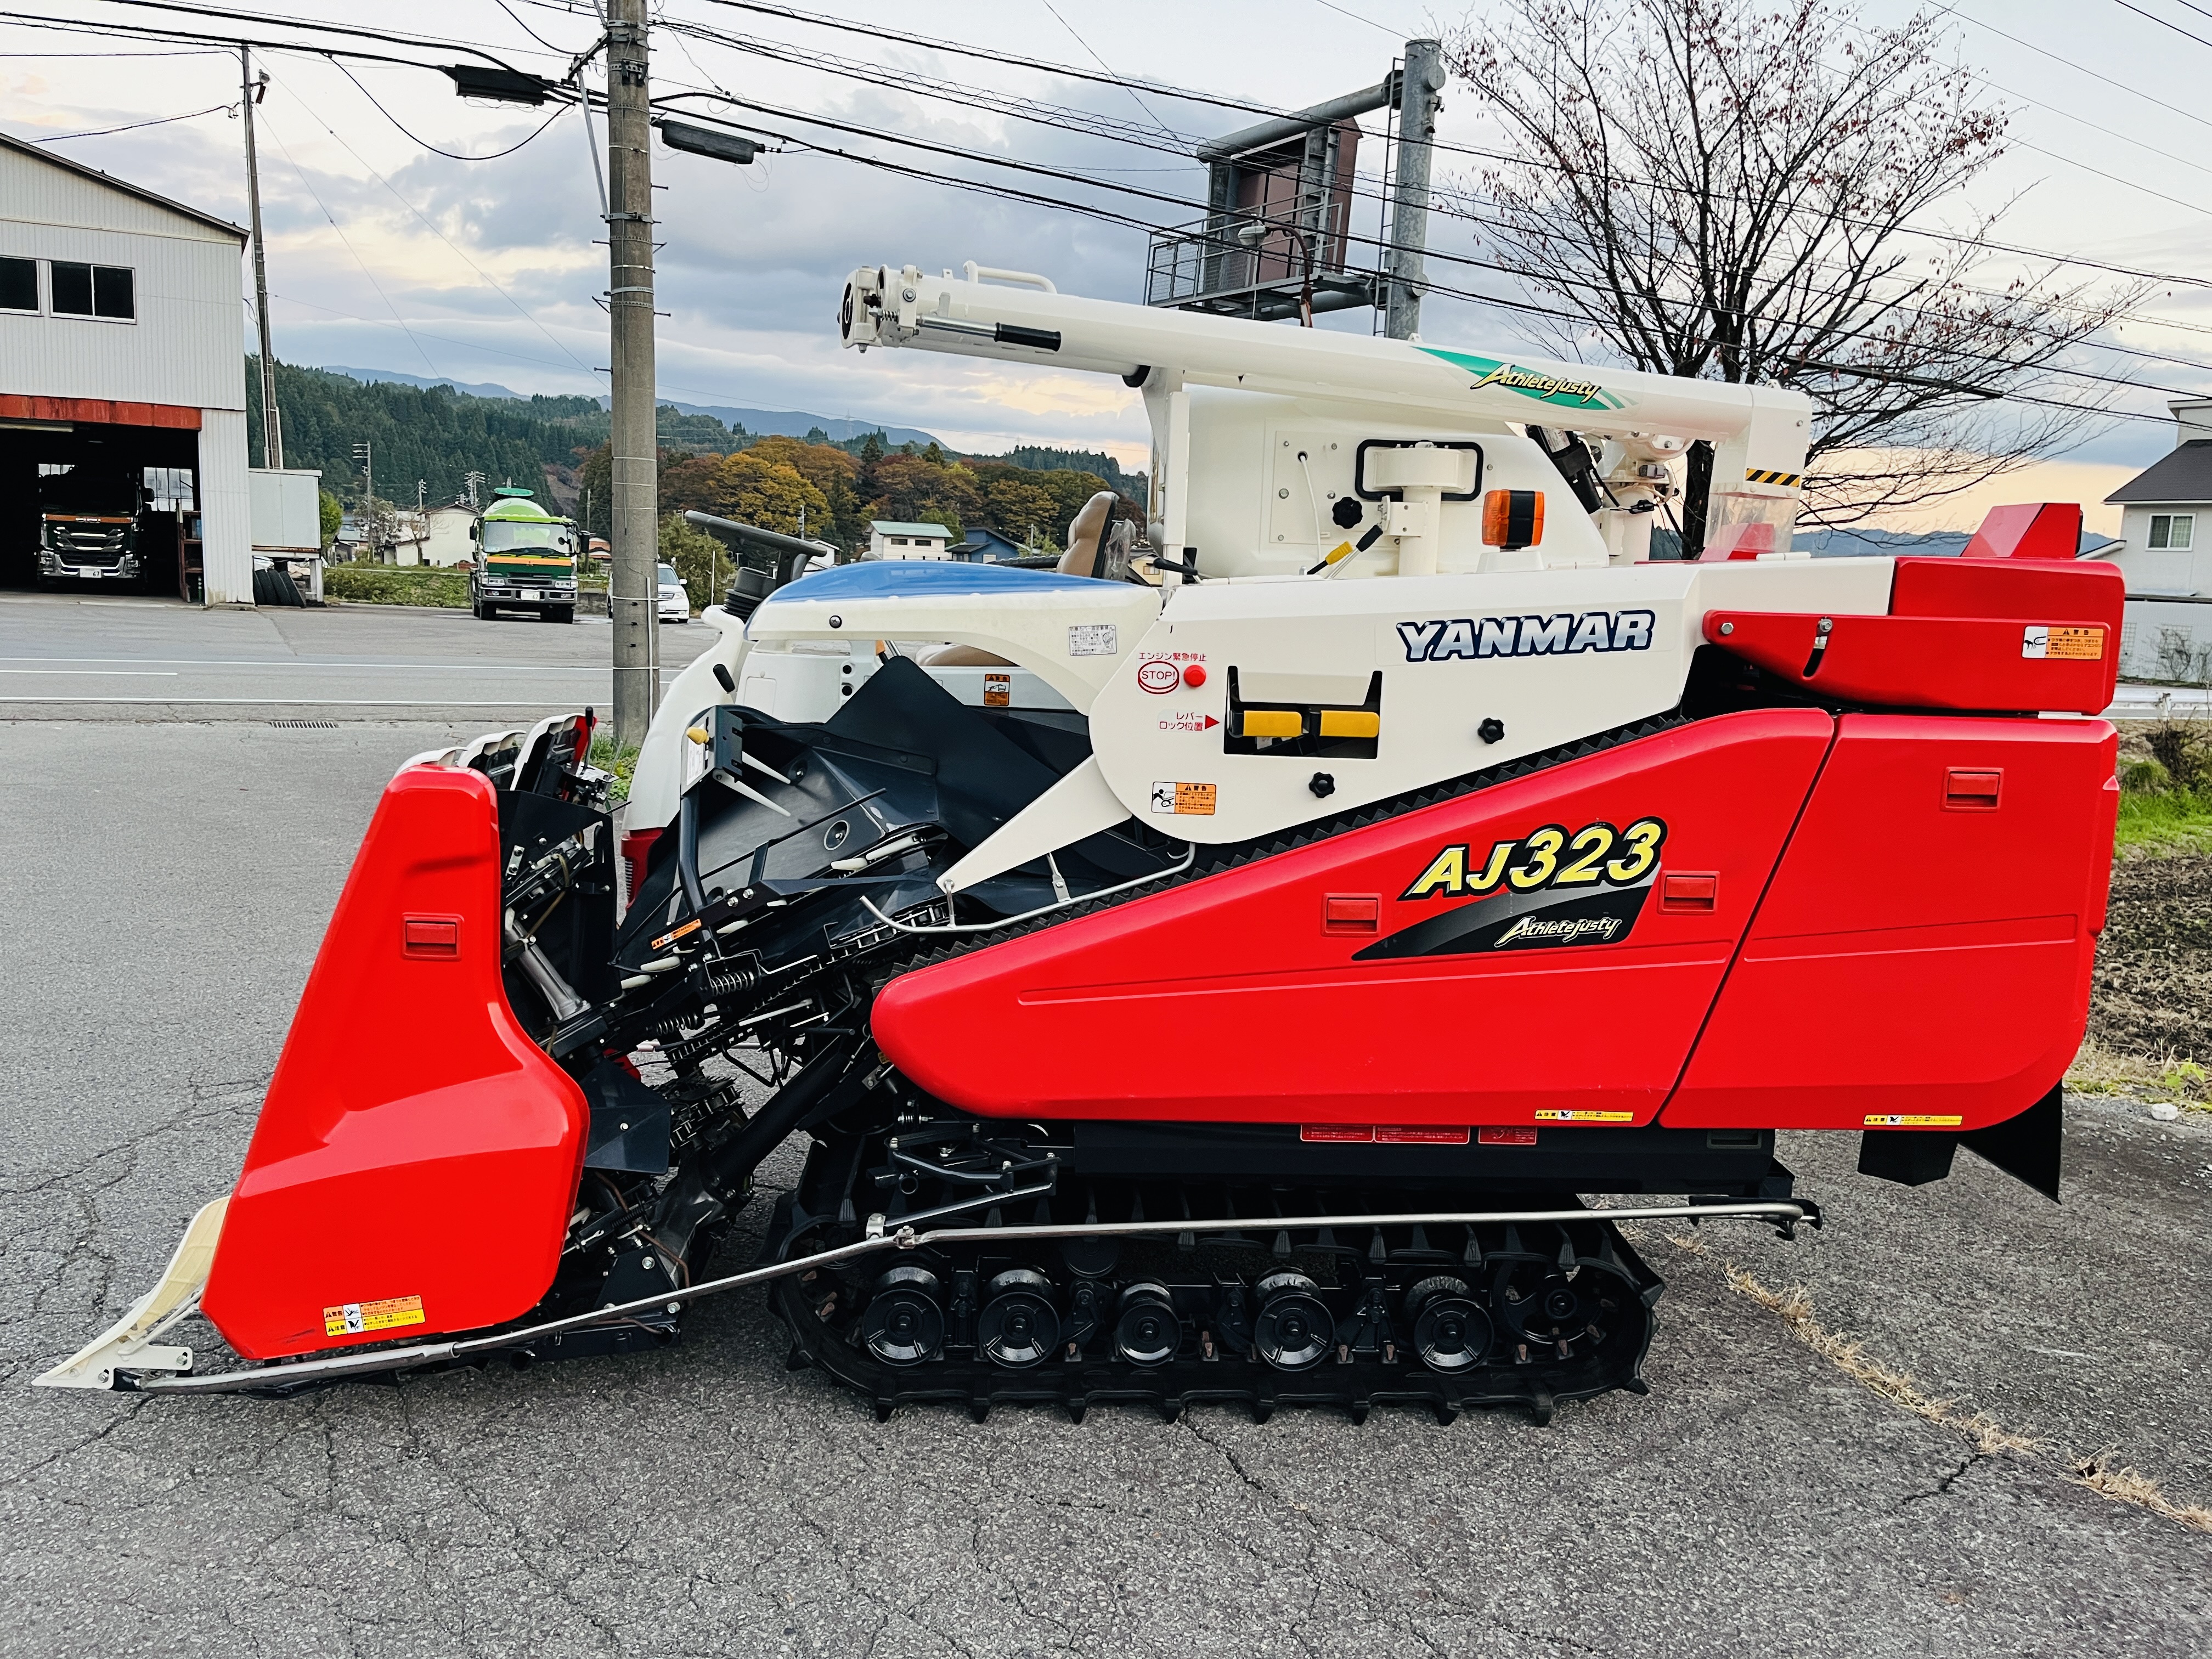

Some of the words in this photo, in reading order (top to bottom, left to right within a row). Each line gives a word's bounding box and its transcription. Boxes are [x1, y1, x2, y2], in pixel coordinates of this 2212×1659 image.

[1396, 609, 1656, 662] YANMAR
[1138, 652, 1207, 662] エンジン緊急停止
[1142, 670, 1175, 680] STOP!
[1176, 712, 1203, 721] レバー
[1159, 721, 1203, 731] ロック位置
[1399, 817, 1666, 899] AJ323
